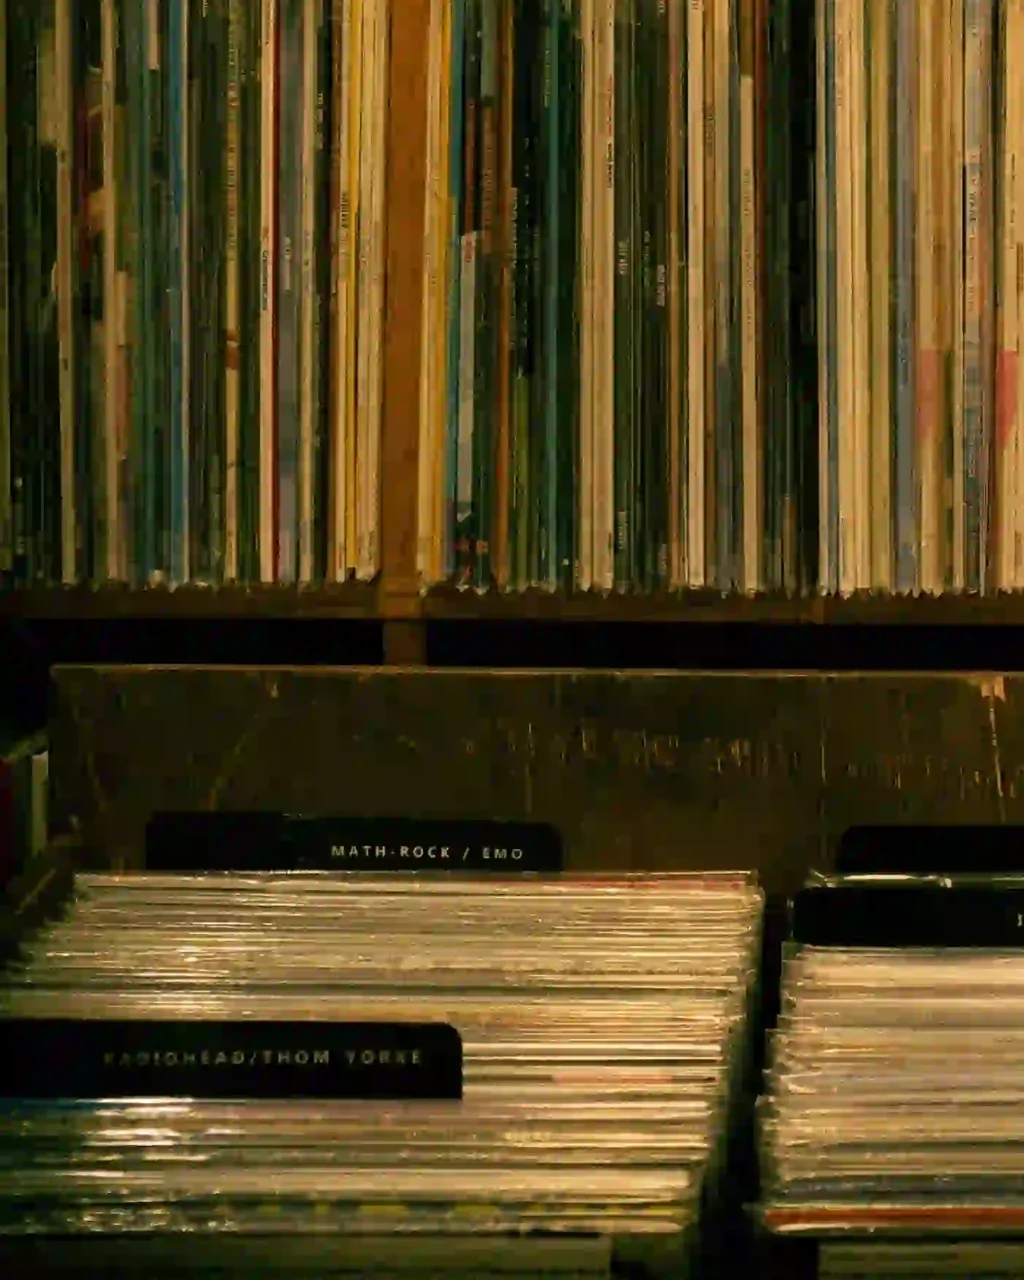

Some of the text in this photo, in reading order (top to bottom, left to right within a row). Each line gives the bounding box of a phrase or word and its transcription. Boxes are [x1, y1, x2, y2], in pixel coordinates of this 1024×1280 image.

[331, 844, 524, 861] MATH-ROCK / EMO
